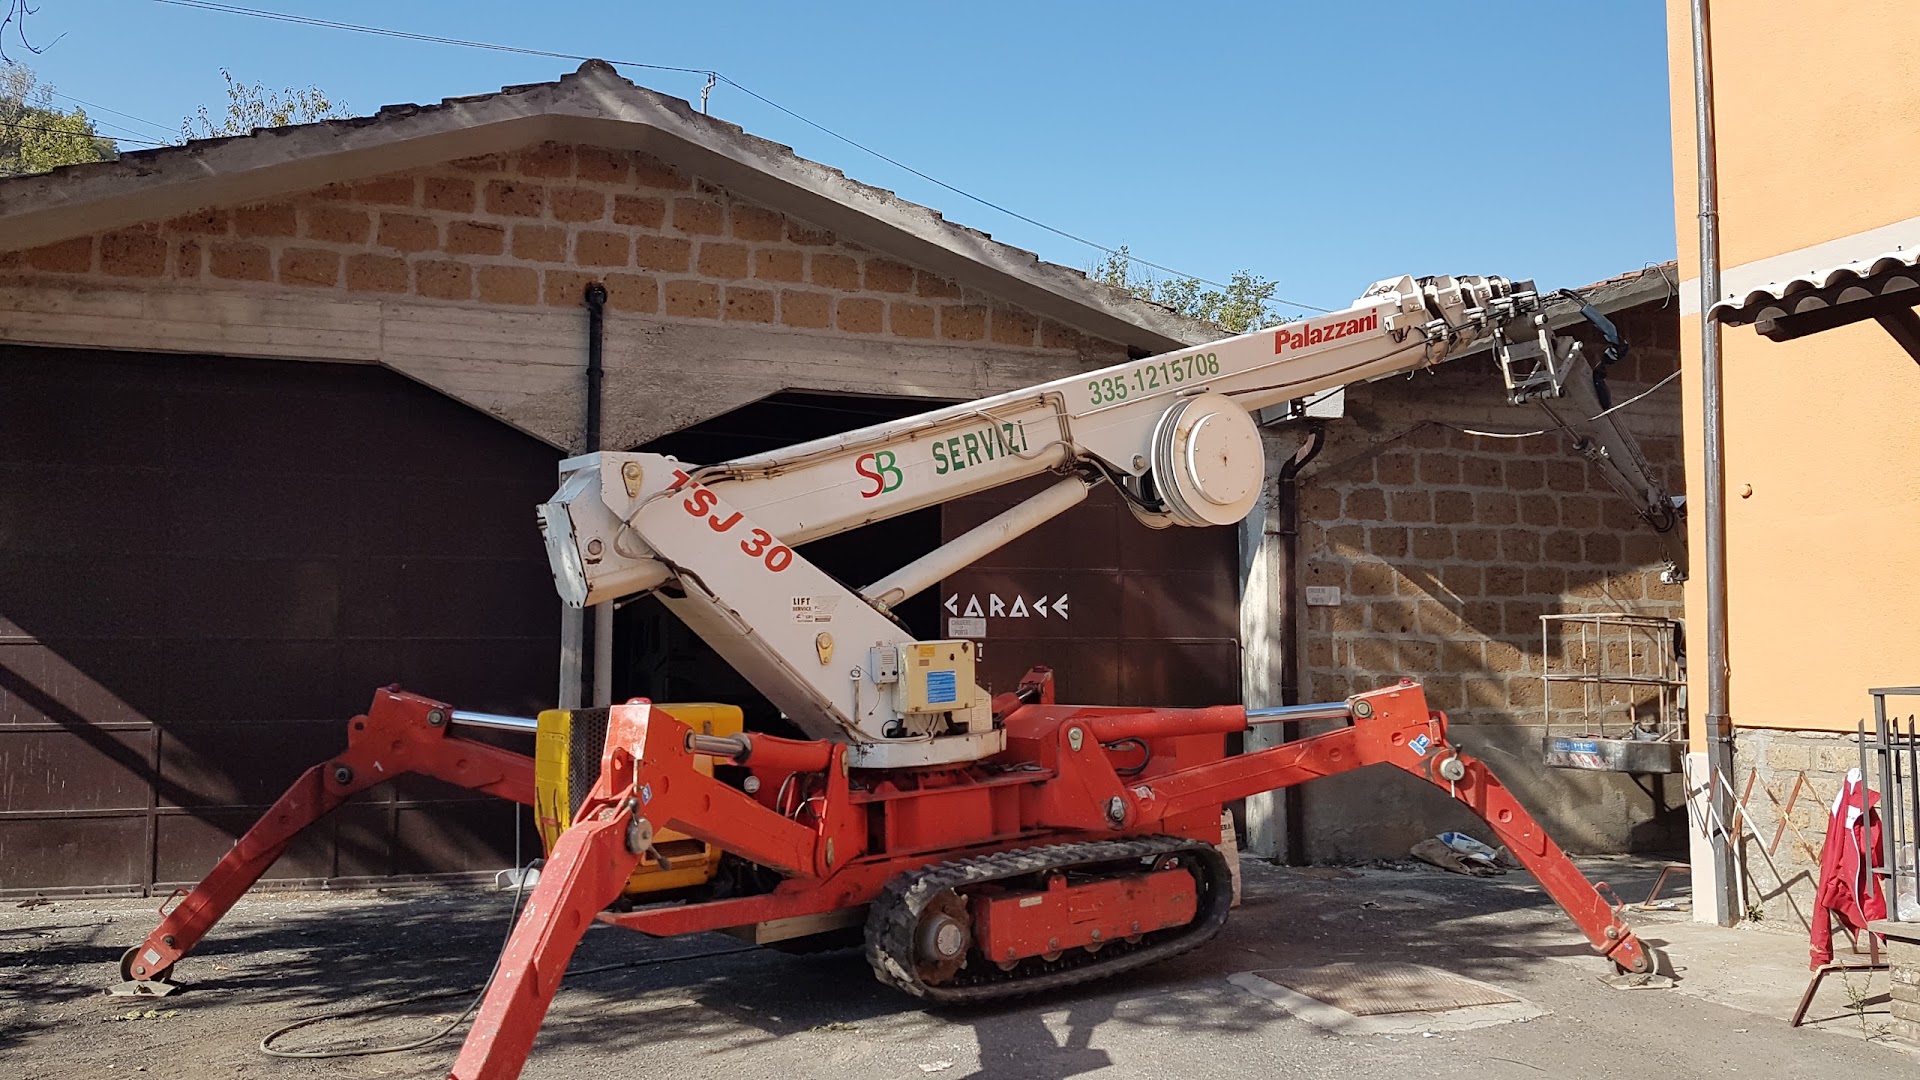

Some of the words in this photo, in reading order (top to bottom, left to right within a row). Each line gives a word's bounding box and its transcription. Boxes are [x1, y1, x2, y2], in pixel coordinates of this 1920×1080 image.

[1274, 308, 1378, 355] Palazzani
[931, 419, 1029, 475] SERVIZI
[665, 469, 745, 533] TSJ
[740, 528, 793, 573] 30
[793, 597, 811, 606] LIFT
[944, 593, 1069, 620] GARAGE
